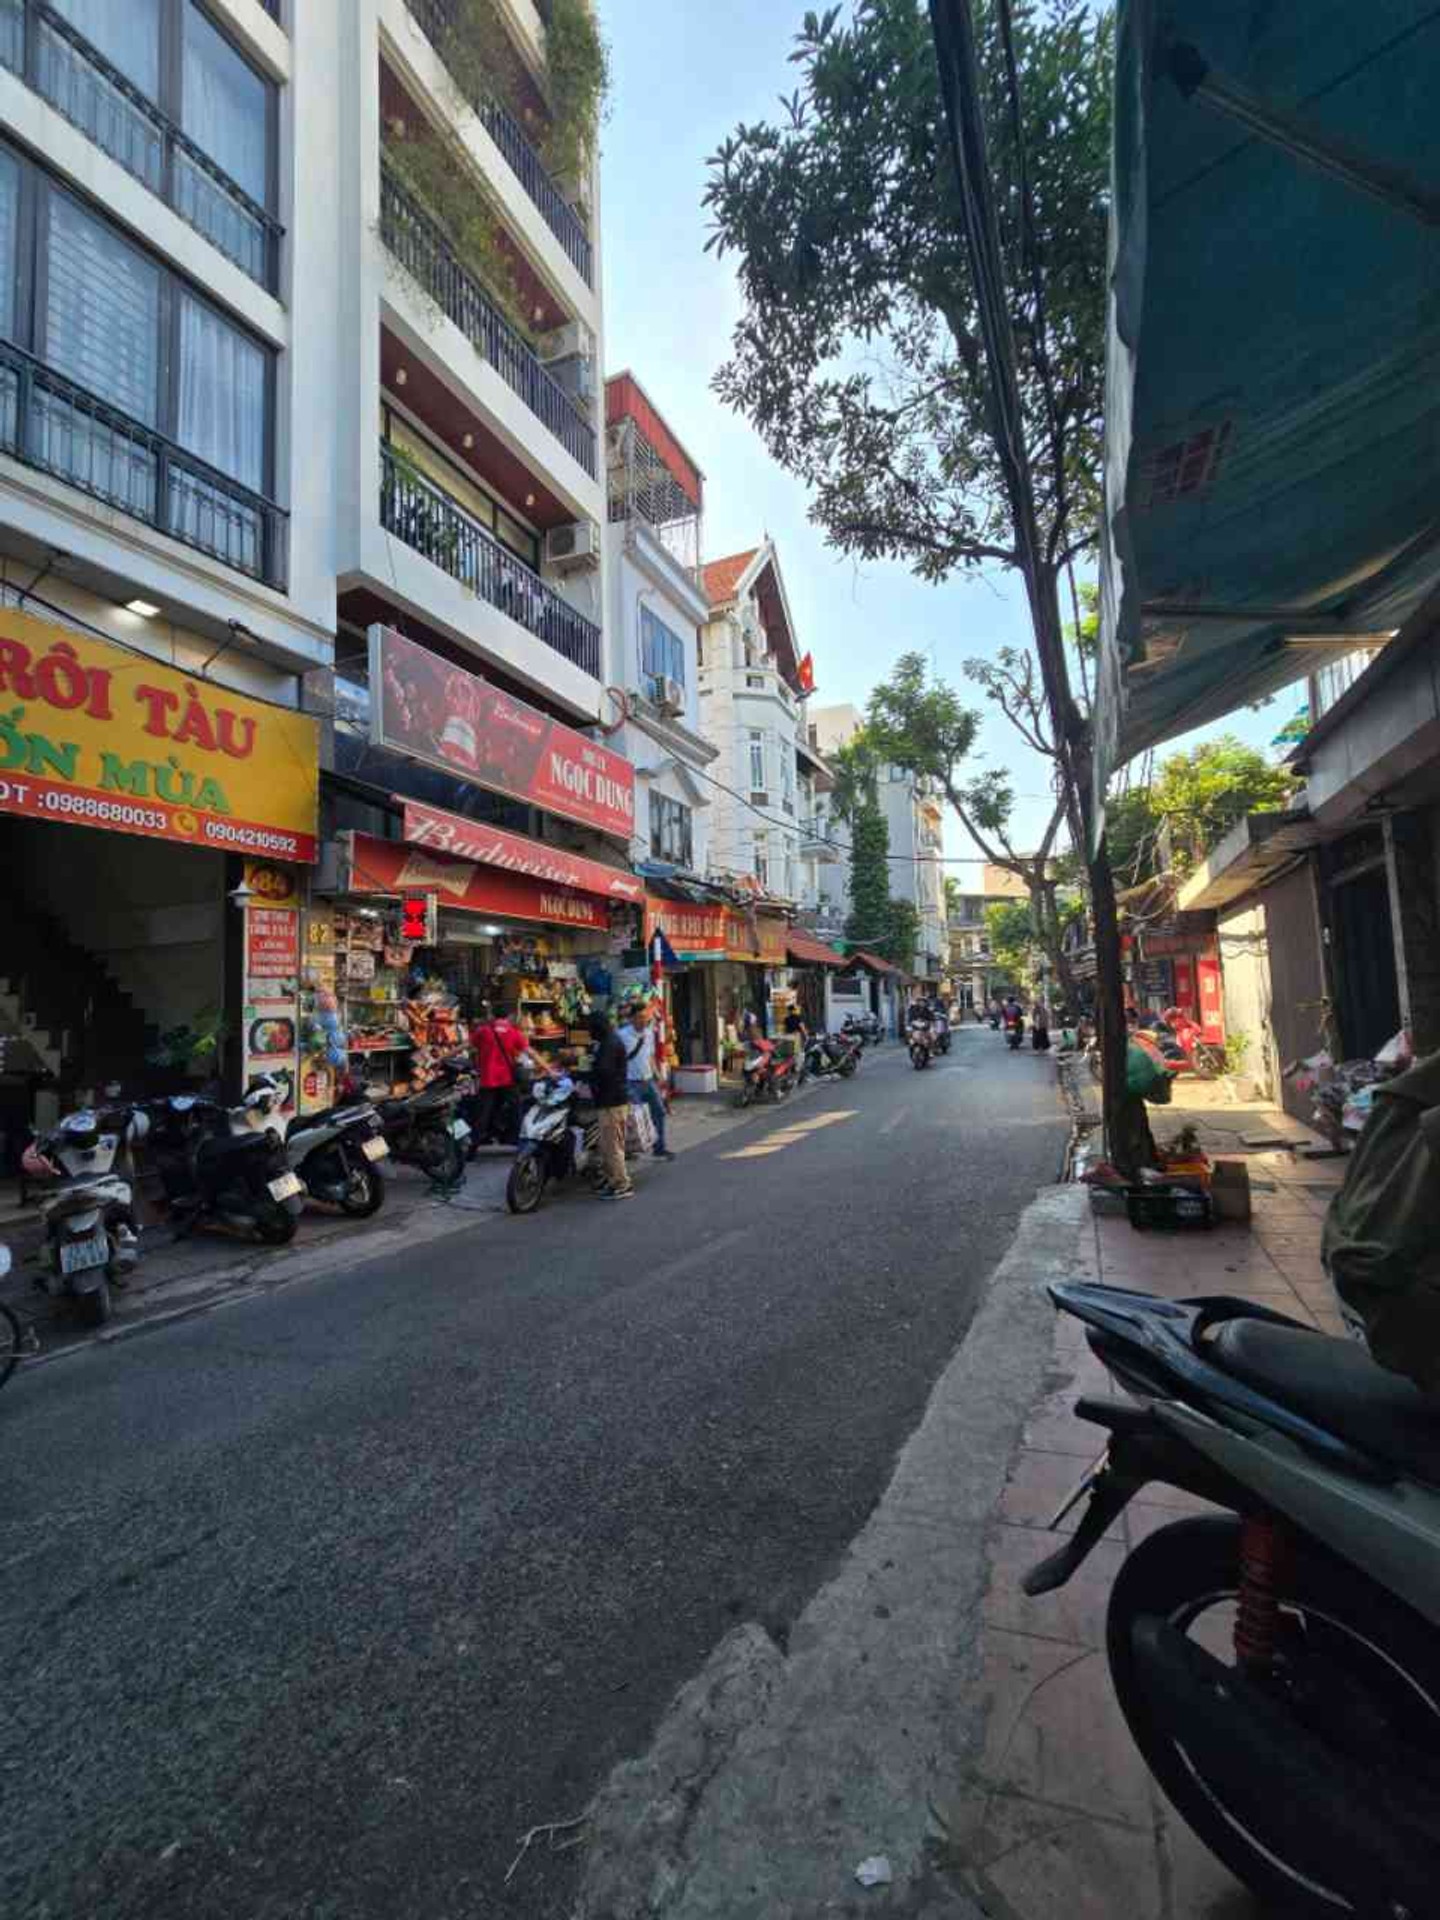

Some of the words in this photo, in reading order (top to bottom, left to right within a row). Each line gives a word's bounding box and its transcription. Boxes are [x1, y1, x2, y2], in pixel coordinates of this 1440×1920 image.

[135, 681, 257, 759] TÀU
[98, 754, 231, 814] MÙA
[551, 753, 594, 801] NGỌC
[595, 773, 634, 817] DUNG
[405, 817, 581, 885] Budweiser
